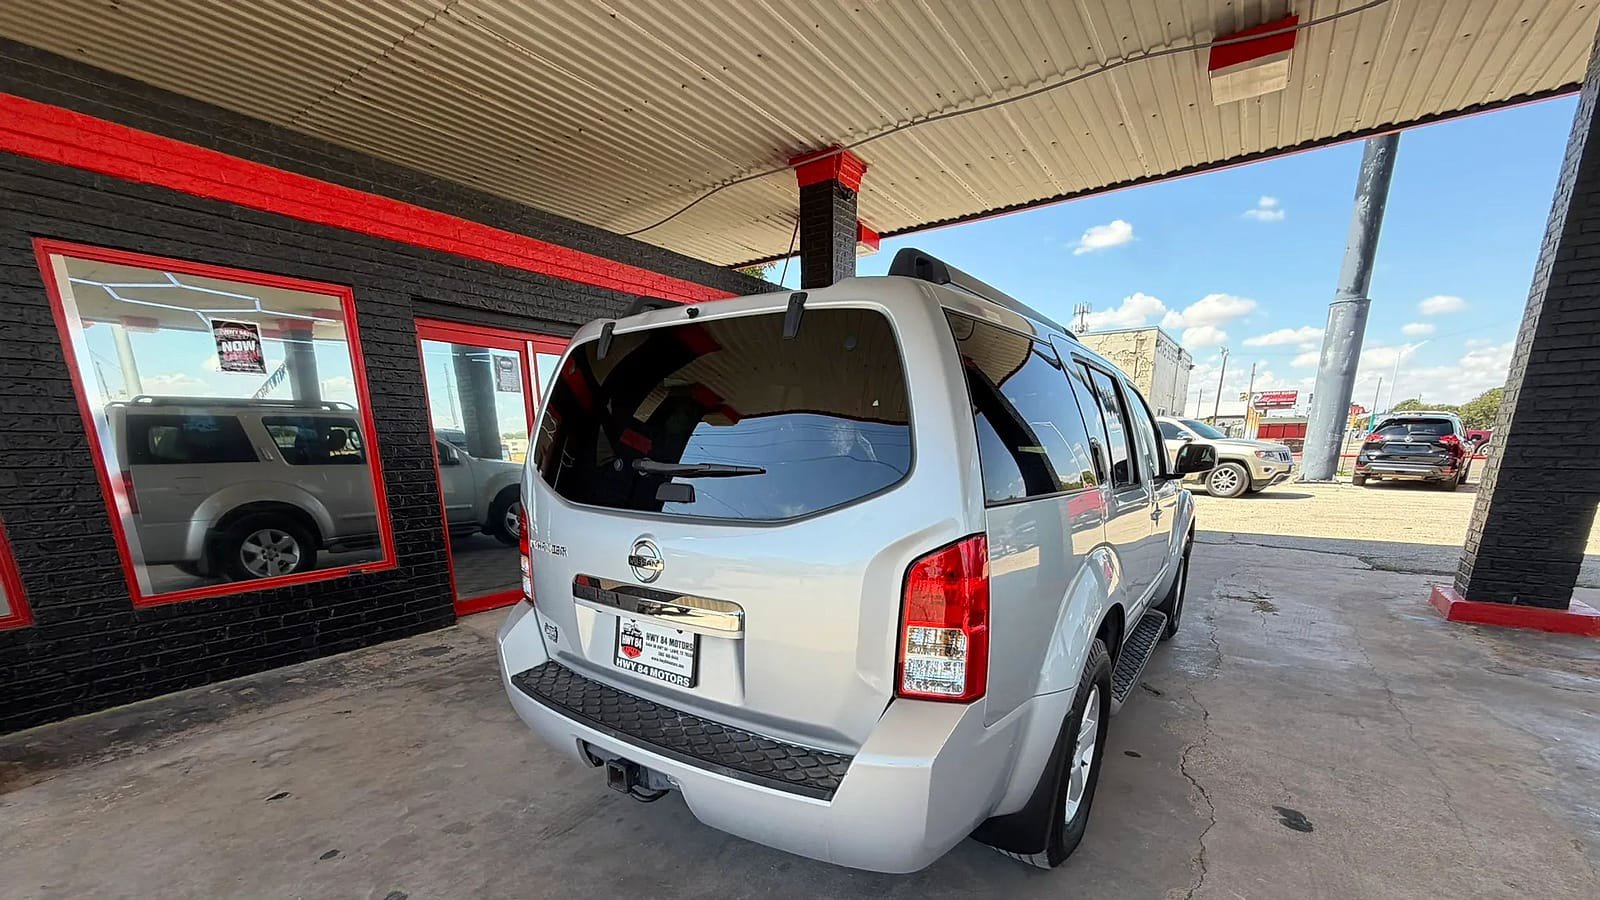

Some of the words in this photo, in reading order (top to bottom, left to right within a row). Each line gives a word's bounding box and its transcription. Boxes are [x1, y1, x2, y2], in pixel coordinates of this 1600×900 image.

[222, 340, 256, 352] NOW
[629, 555, 660, 568] NISSAN
[646, 632, 659, 643] HWY
[660, 635, 668, 645] 84
[669, 638, 694, 651] MOTORS
[616, 657, 637, 671] HWY
[637, 665, 648, 675] 84
[649, 666, 690, 687] MOTORS
